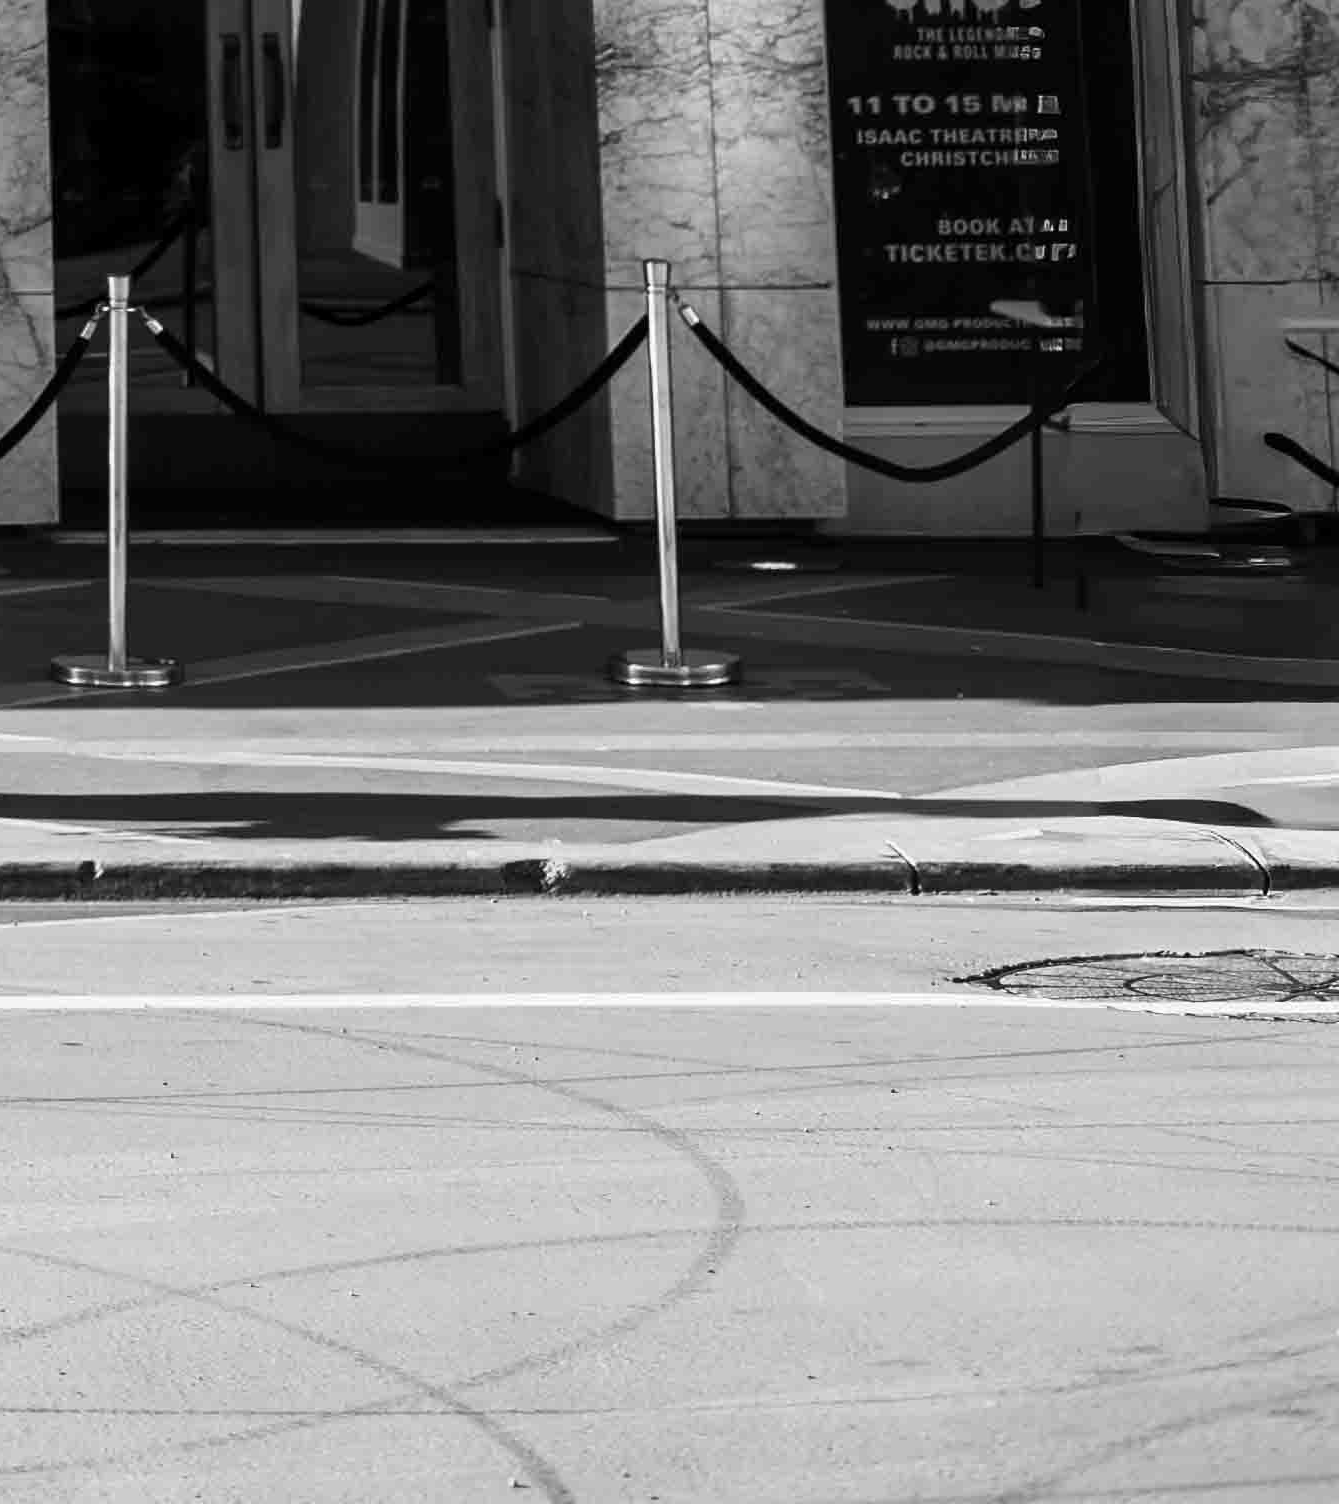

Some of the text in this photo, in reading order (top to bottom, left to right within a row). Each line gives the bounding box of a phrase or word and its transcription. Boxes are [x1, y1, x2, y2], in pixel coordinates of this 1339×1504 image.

[846, 95, 882, 115] 11
[890, 95, 937, 115] TO
[856, 128, 923, 145] ISAAC
[900, 150, 1059, 168] CHRISTCH
[937, 218, 1001, 236] BOOK
